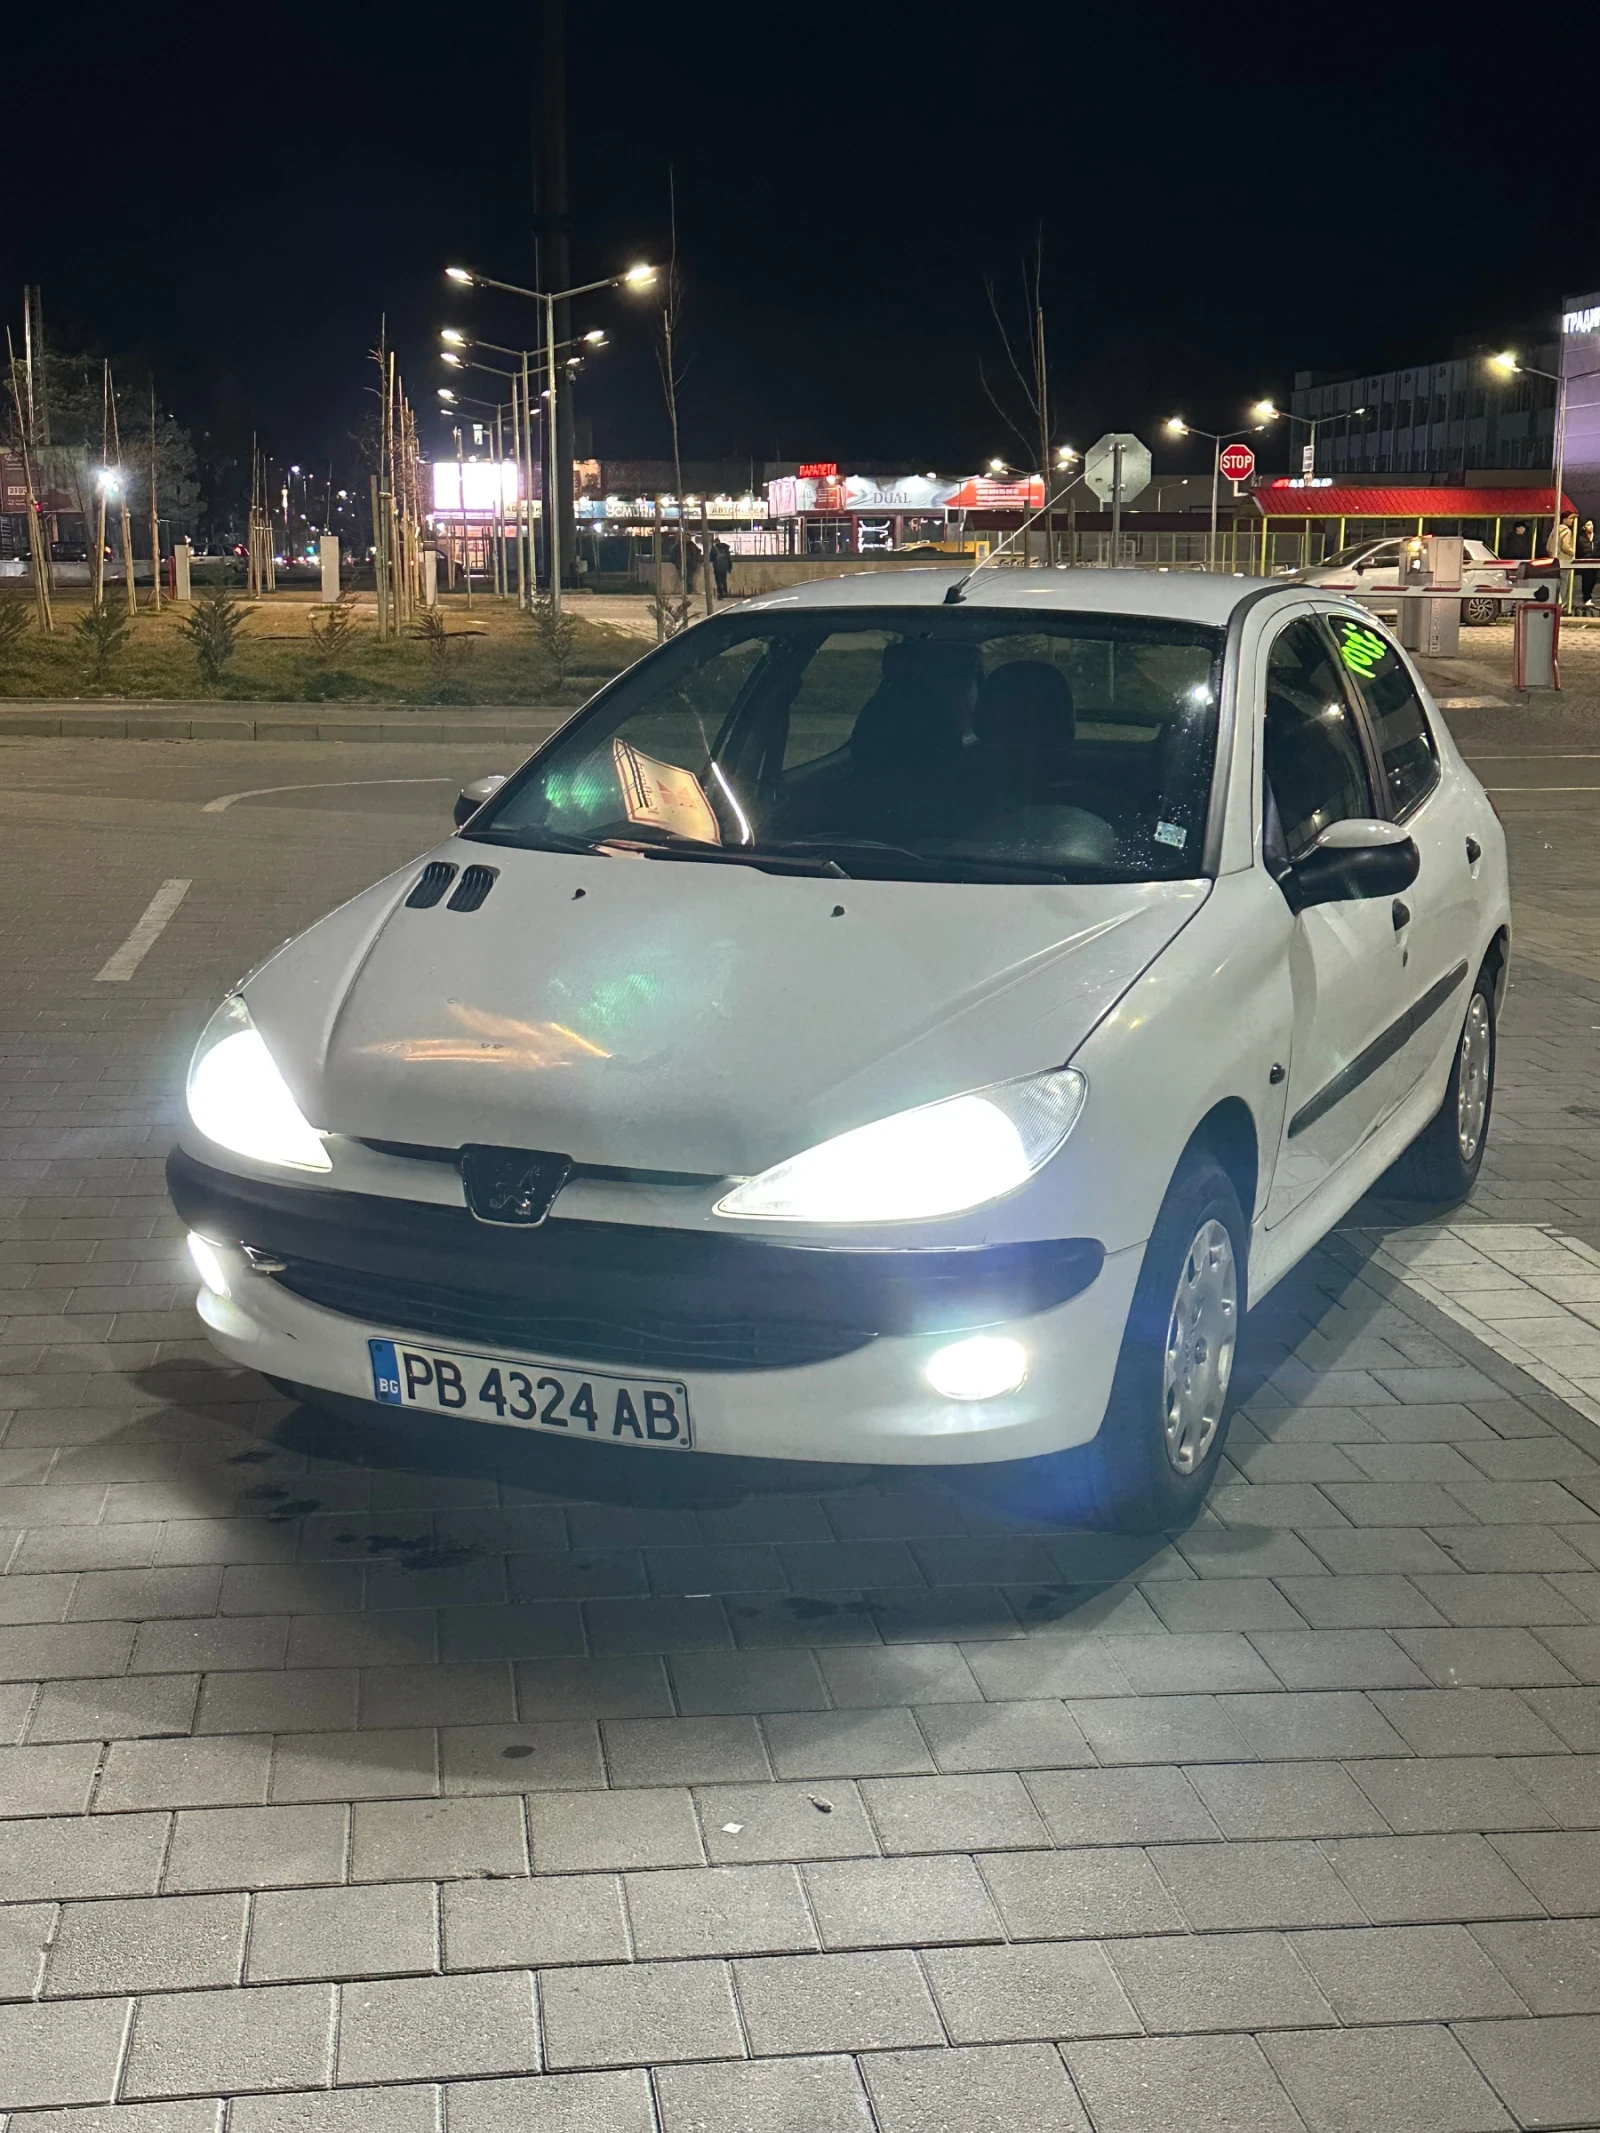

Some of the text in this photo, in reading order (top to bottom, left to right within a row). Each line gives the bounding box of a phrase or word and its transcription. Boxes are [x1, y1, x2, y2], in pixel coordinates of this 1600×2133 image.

[1222, 455, 1252, 469] STOP
[873, 492, 912, 504] DUAL
[379, 1378, 399, 1394] BG
[402, 1352, 680, 1441] PB 4324 AB
